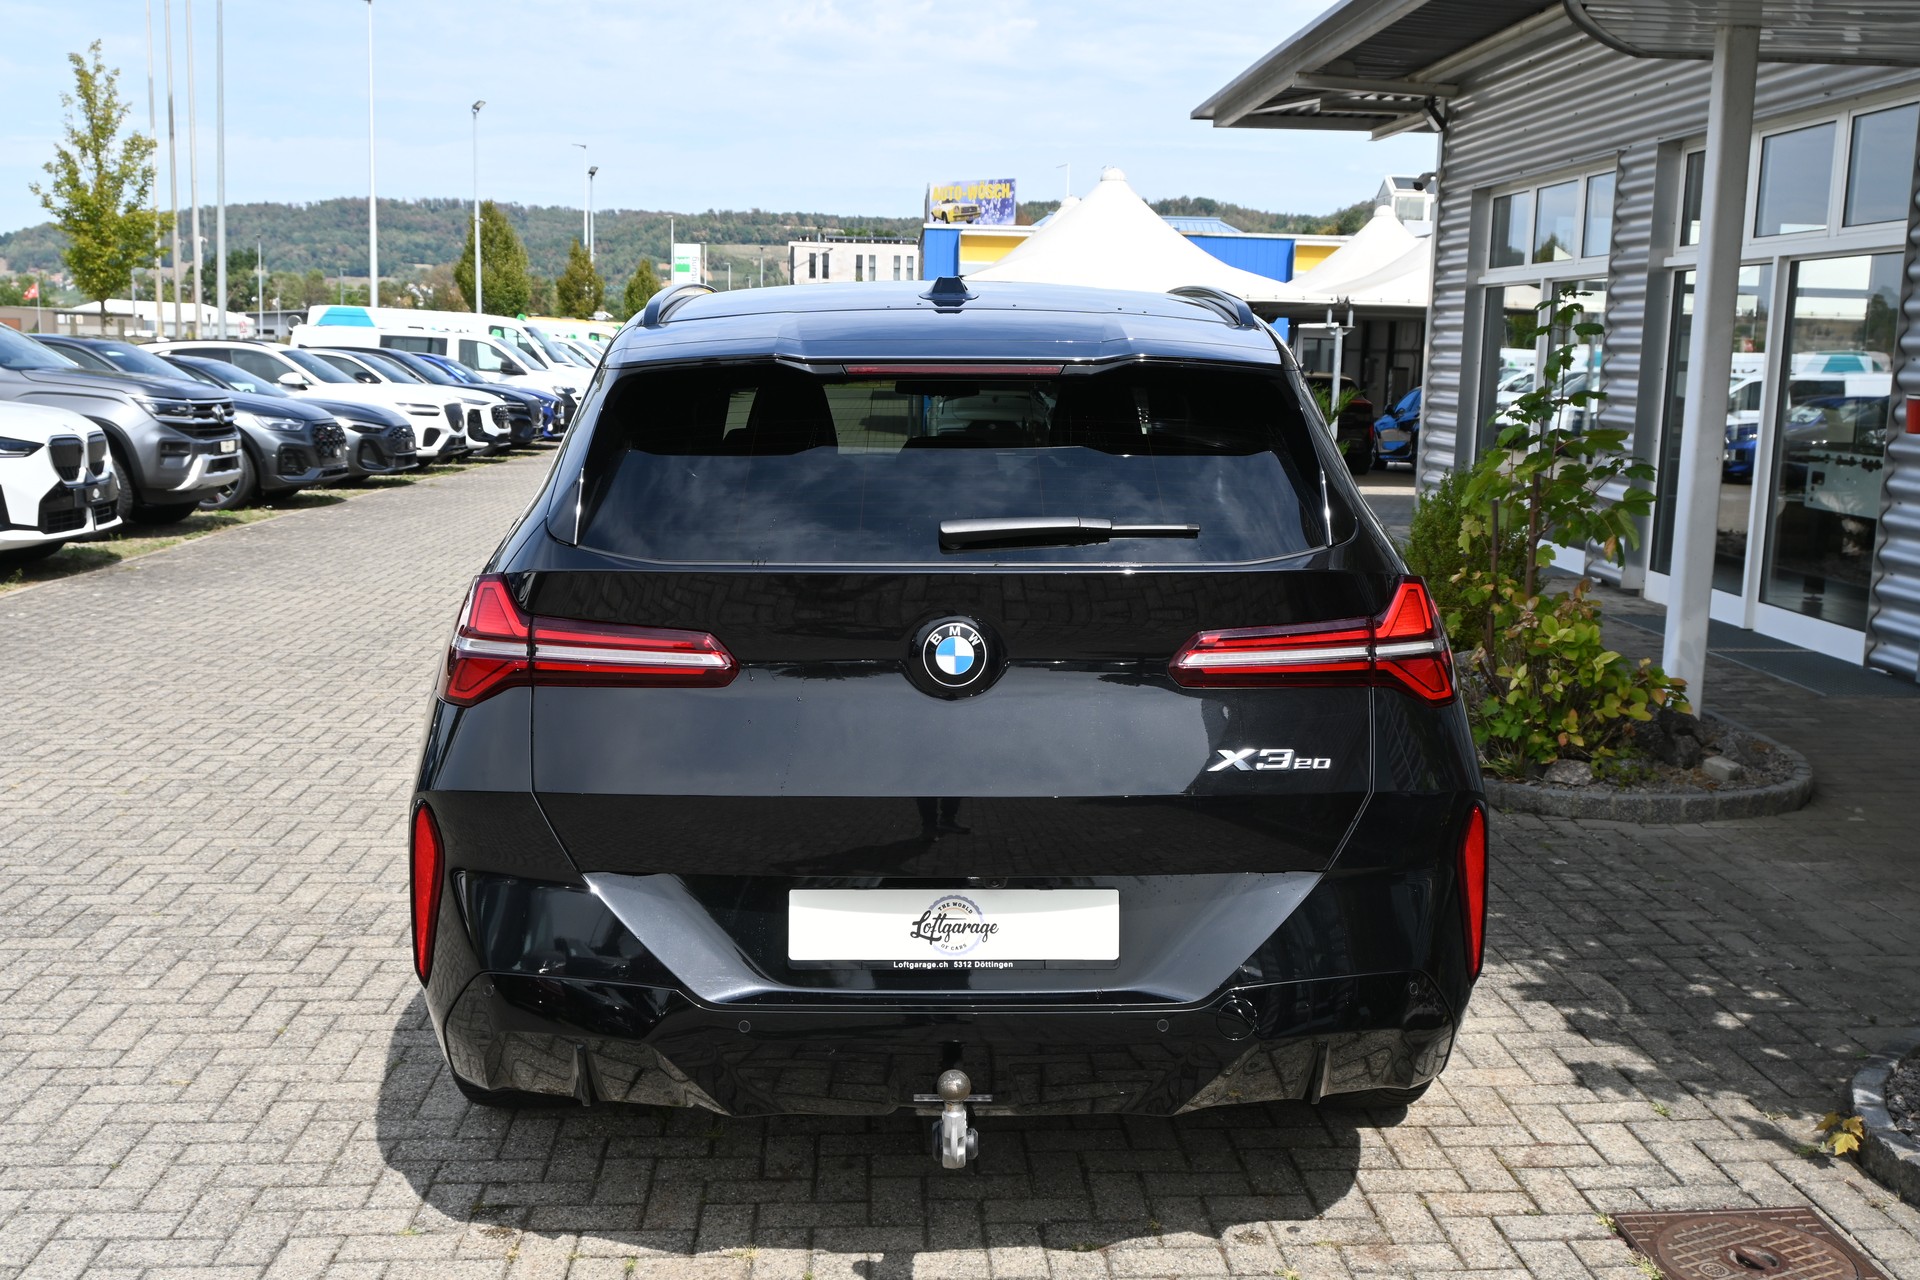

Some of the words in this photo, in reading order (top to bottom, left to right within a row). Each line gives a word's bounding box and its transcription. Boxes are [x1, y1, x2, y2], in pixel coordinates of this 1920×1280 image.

[929, 626, 980, 646] BMW
[938, 902, 950, 911] THE
[952, 902, 973, 914] WORLD
[910, 910, 999, 945] Loftgarage
[893, 961, 949, 970] Loftgarage.ch
[974, 960, 1014, 970] Döttingen
